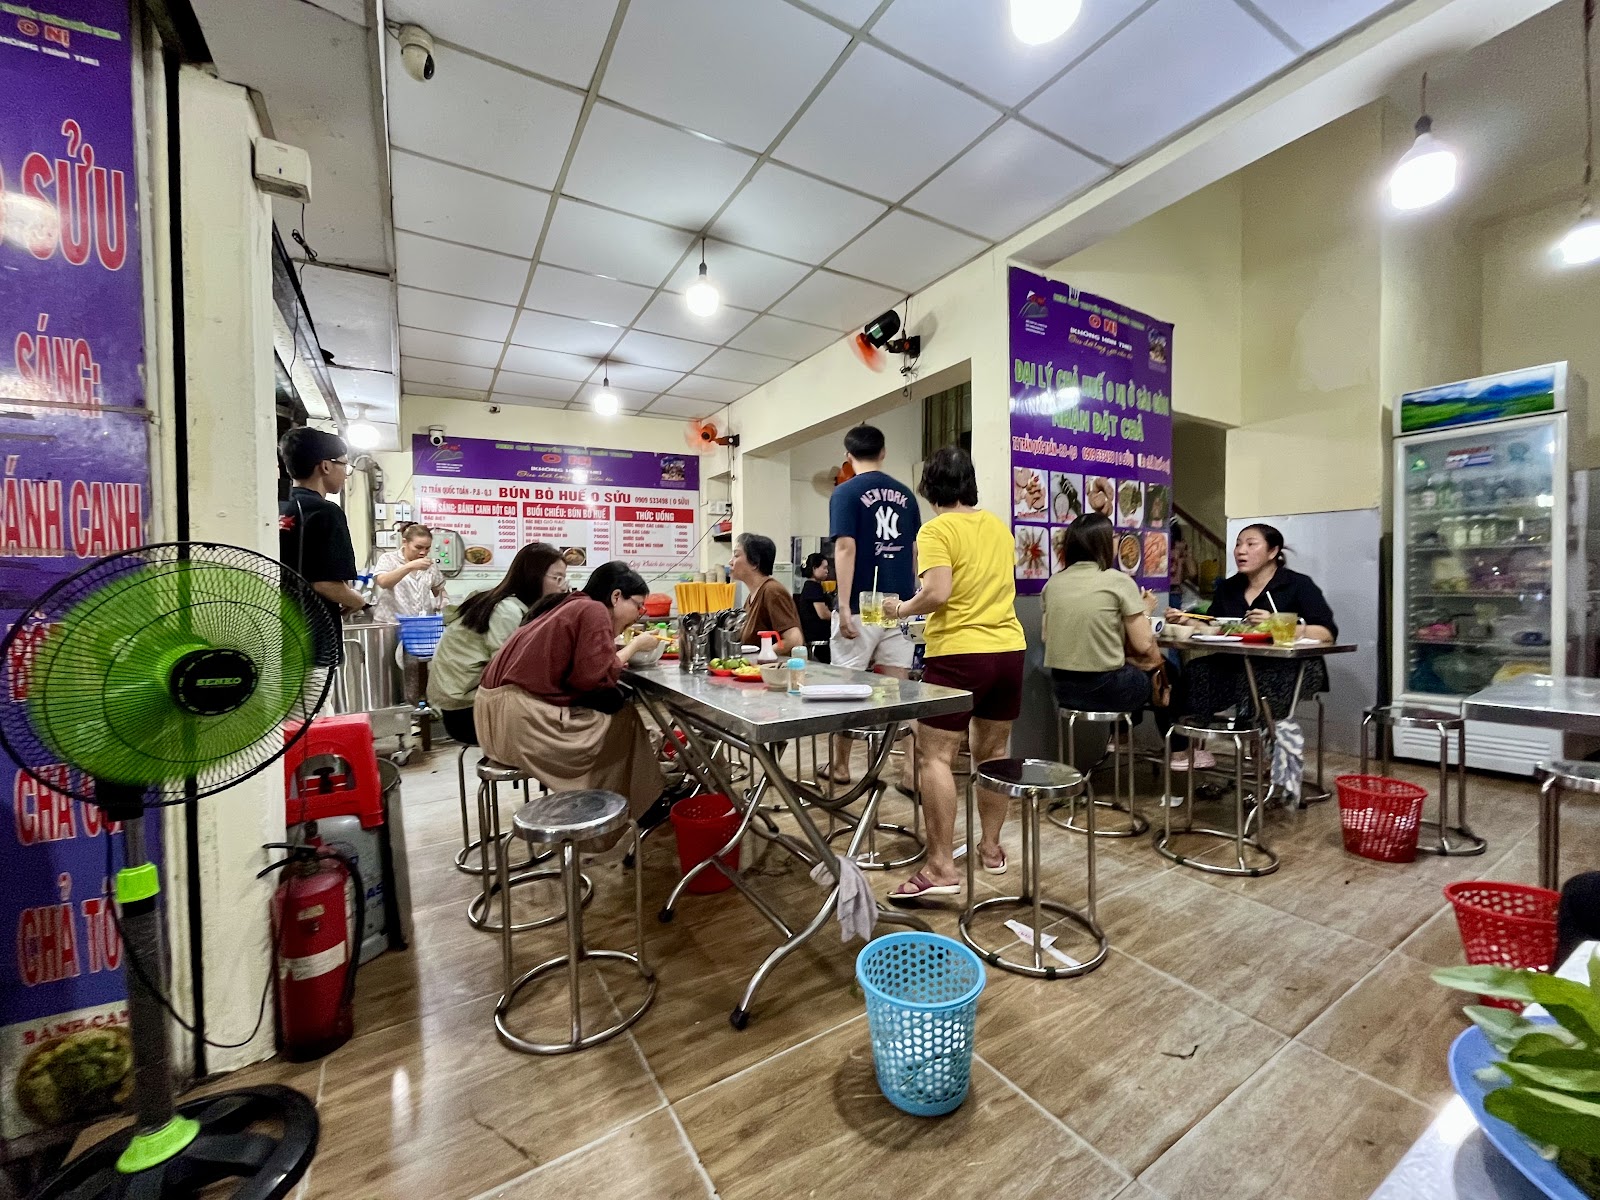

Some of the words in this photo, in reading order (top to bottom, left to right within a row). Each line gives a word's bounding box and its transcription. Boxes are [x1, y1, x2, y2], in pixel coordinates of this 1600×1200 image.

[22, 119, 127, 271] SỬU
[15, 313, 102, 419] SÁNG:
[1015, 358, 1035, 389] ĐẠI
[1038, 361, 1053, 390] LÝ
[1092, 409, 1119, 441] ĐẶT
[0, 455, 64, 558] ÁNH
[70, 480, 143, 559] CANH
[499, 486, 530, 499] BÚN
[535, 487, 554, 500] BÒ
[559, 489, 587, 501] HUẾ
[604, 490, 631, 504] SỬU
[860, 488, 882, 508] NEW
[880, 488, 908, 508] YORK
[458, 502, 474, 514] BÁNH
[475, 504, 491, 515] CANH
[526, 504, 543, 516] BUỔI
[635, 509, 654, 520] THỨC
[655, 509, 675, 521] UỐNG
